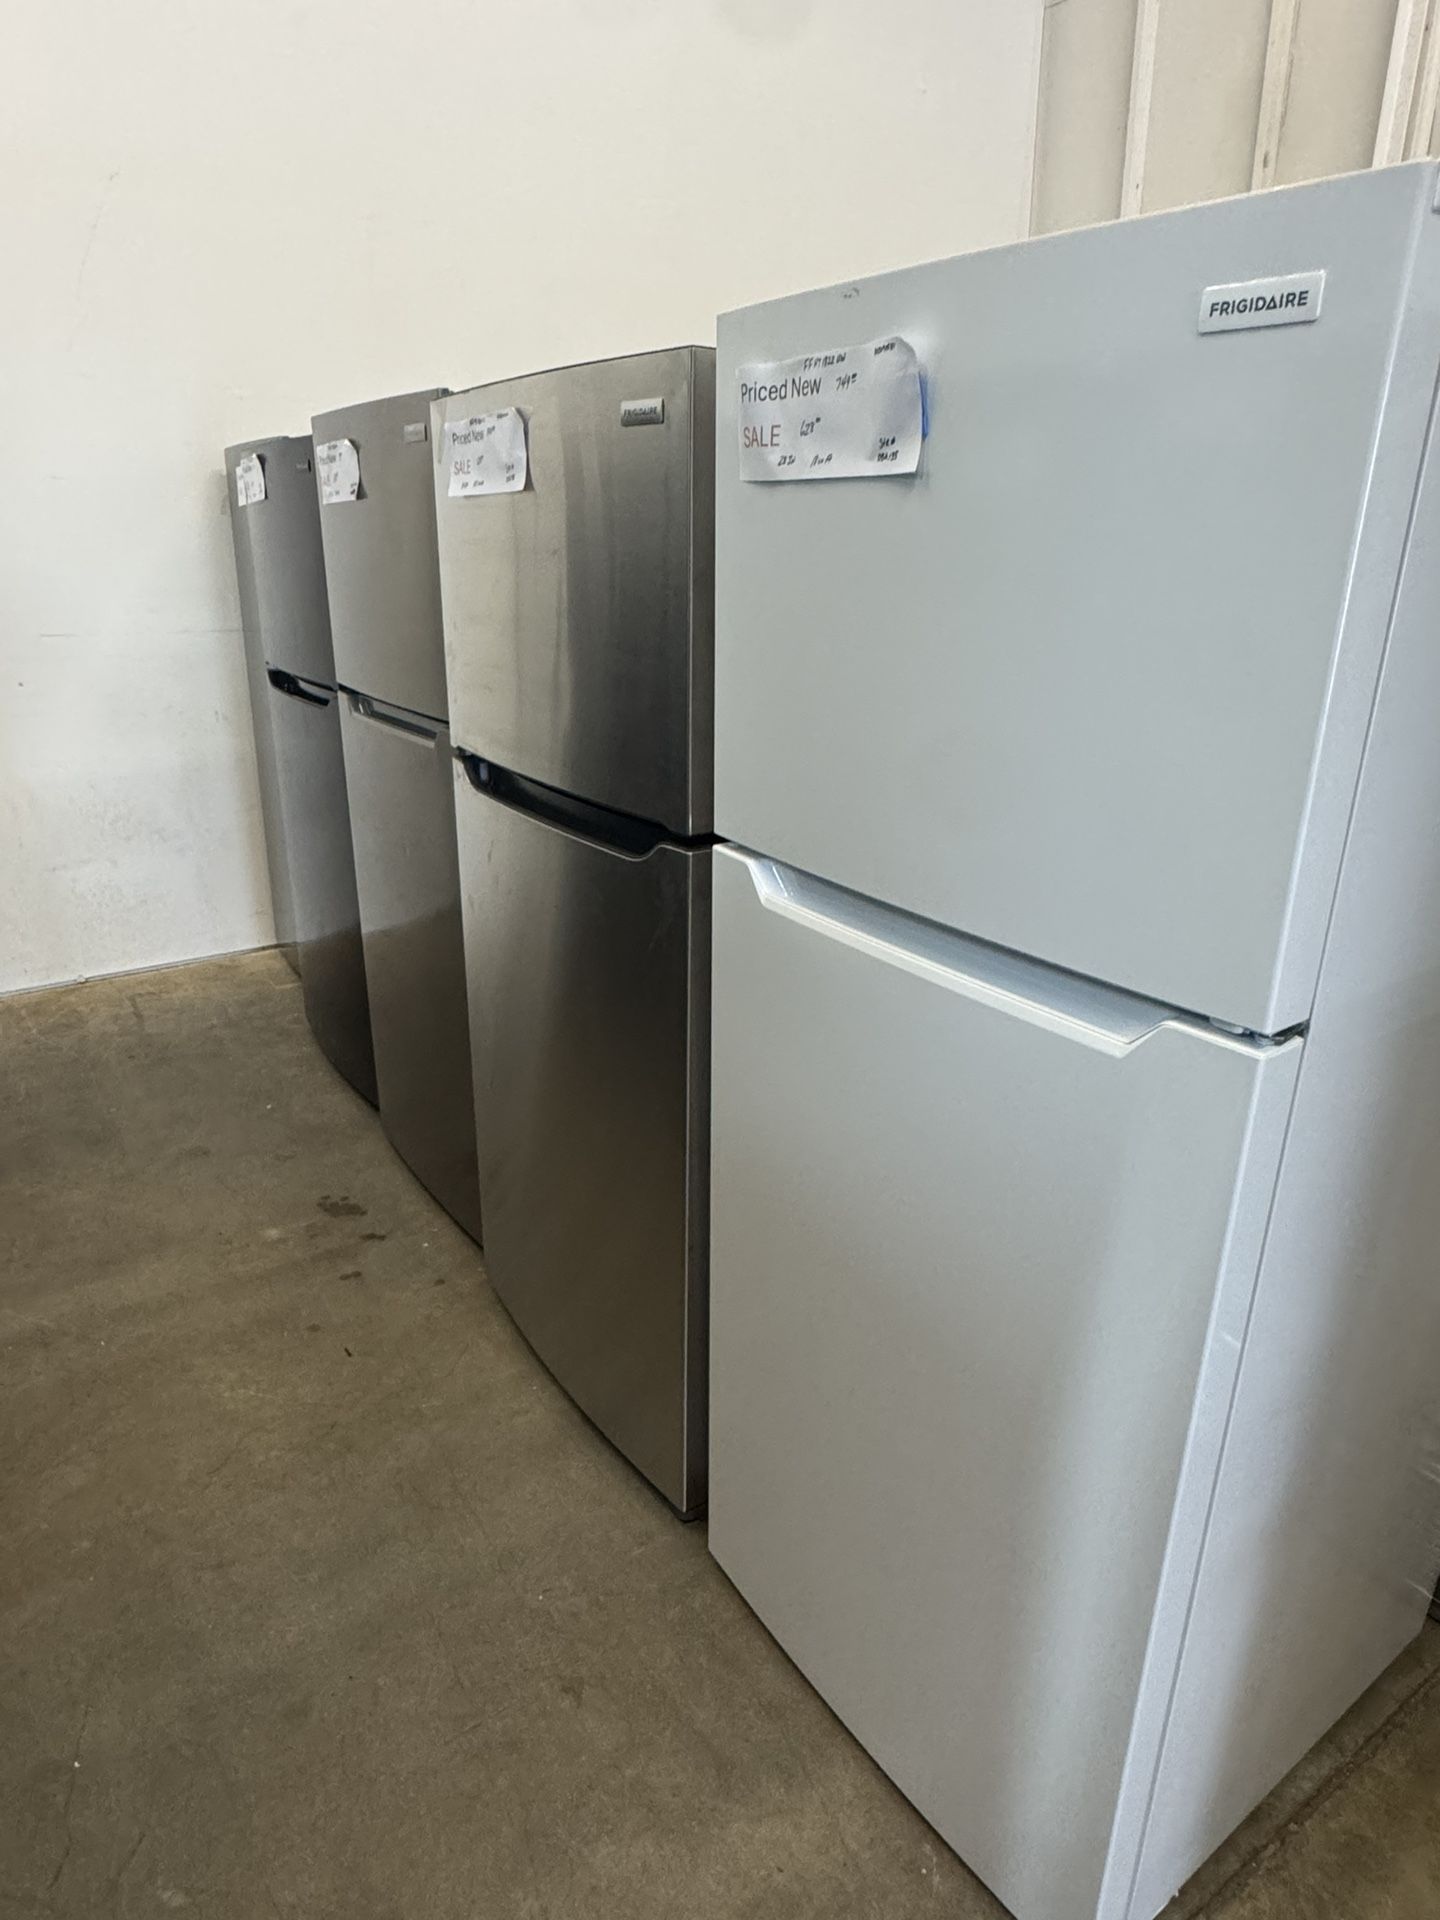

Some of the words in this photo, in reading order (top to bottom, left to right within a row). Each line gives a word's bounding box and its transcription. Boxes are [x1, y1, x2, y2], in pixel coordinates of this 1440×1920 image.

[1209, 290, 1309, 317] FRIGIDAIRE
[741, 379, 788, 403] Priced
[791, 376, 822, 398] New
[743, 424, 781, 448] SALE
[454, 459, 471, 476] SALE
